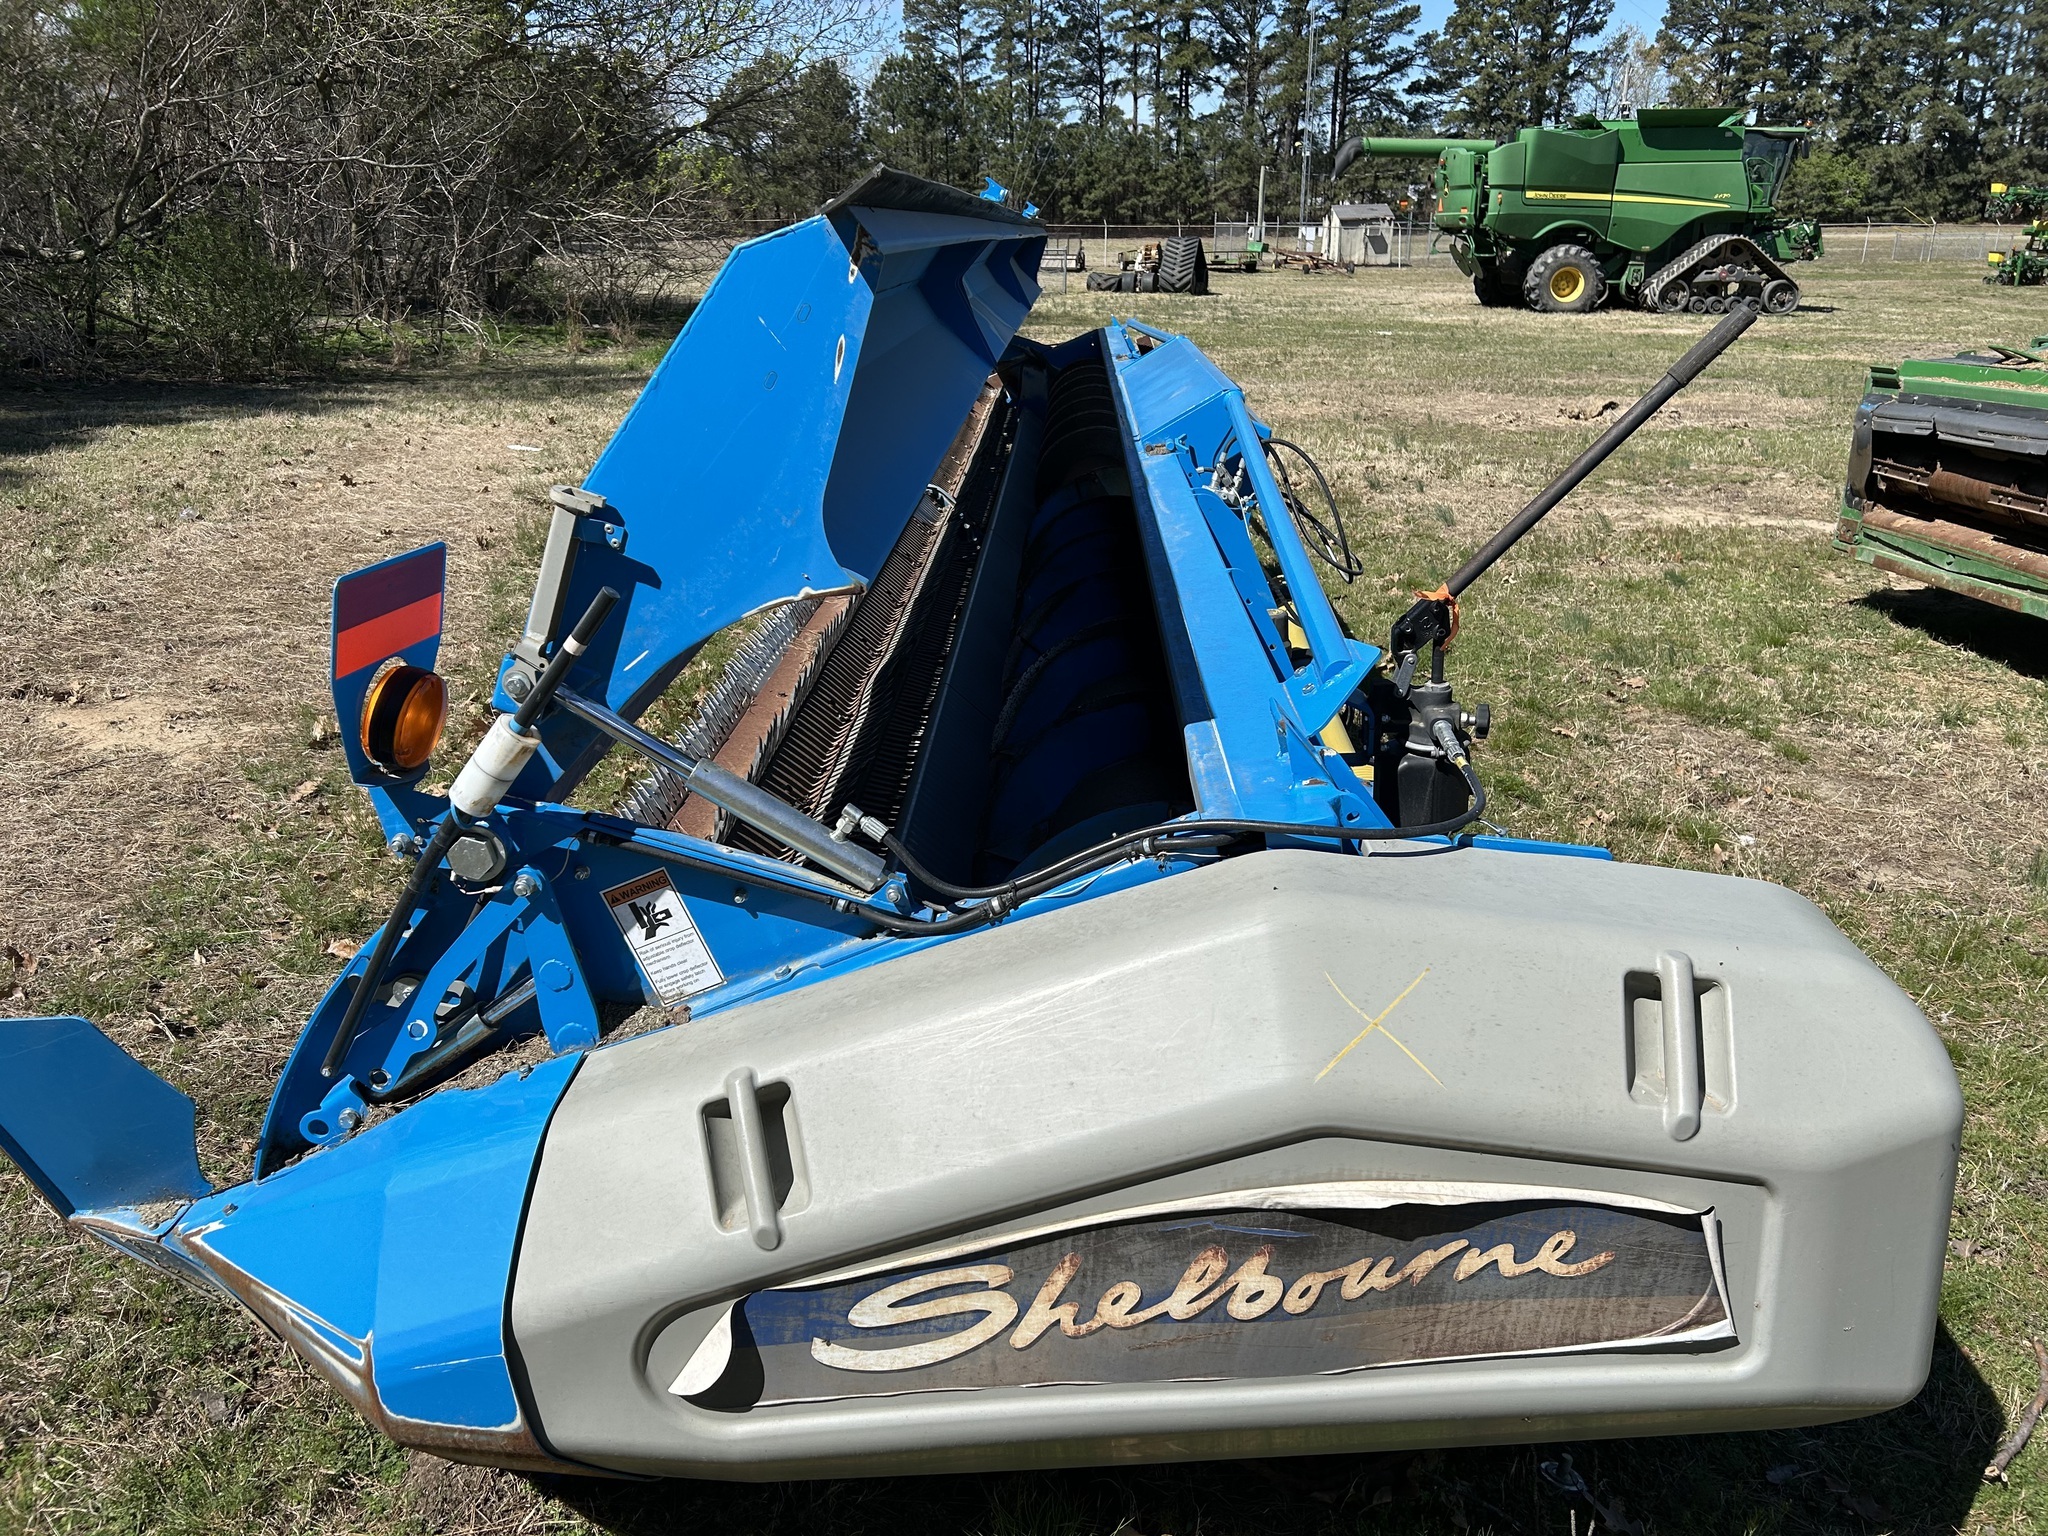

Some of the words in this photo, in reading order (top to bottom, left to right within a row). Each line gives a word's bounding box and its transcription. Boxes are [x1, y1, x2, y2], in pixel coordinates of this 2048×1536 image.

[620, 876, 667, 898] WARNING
[676, 939, 694, 948] deflector
[690, 962, 707, 970] deflector
[811, 1229, 1616, 1373] Shelbourne
